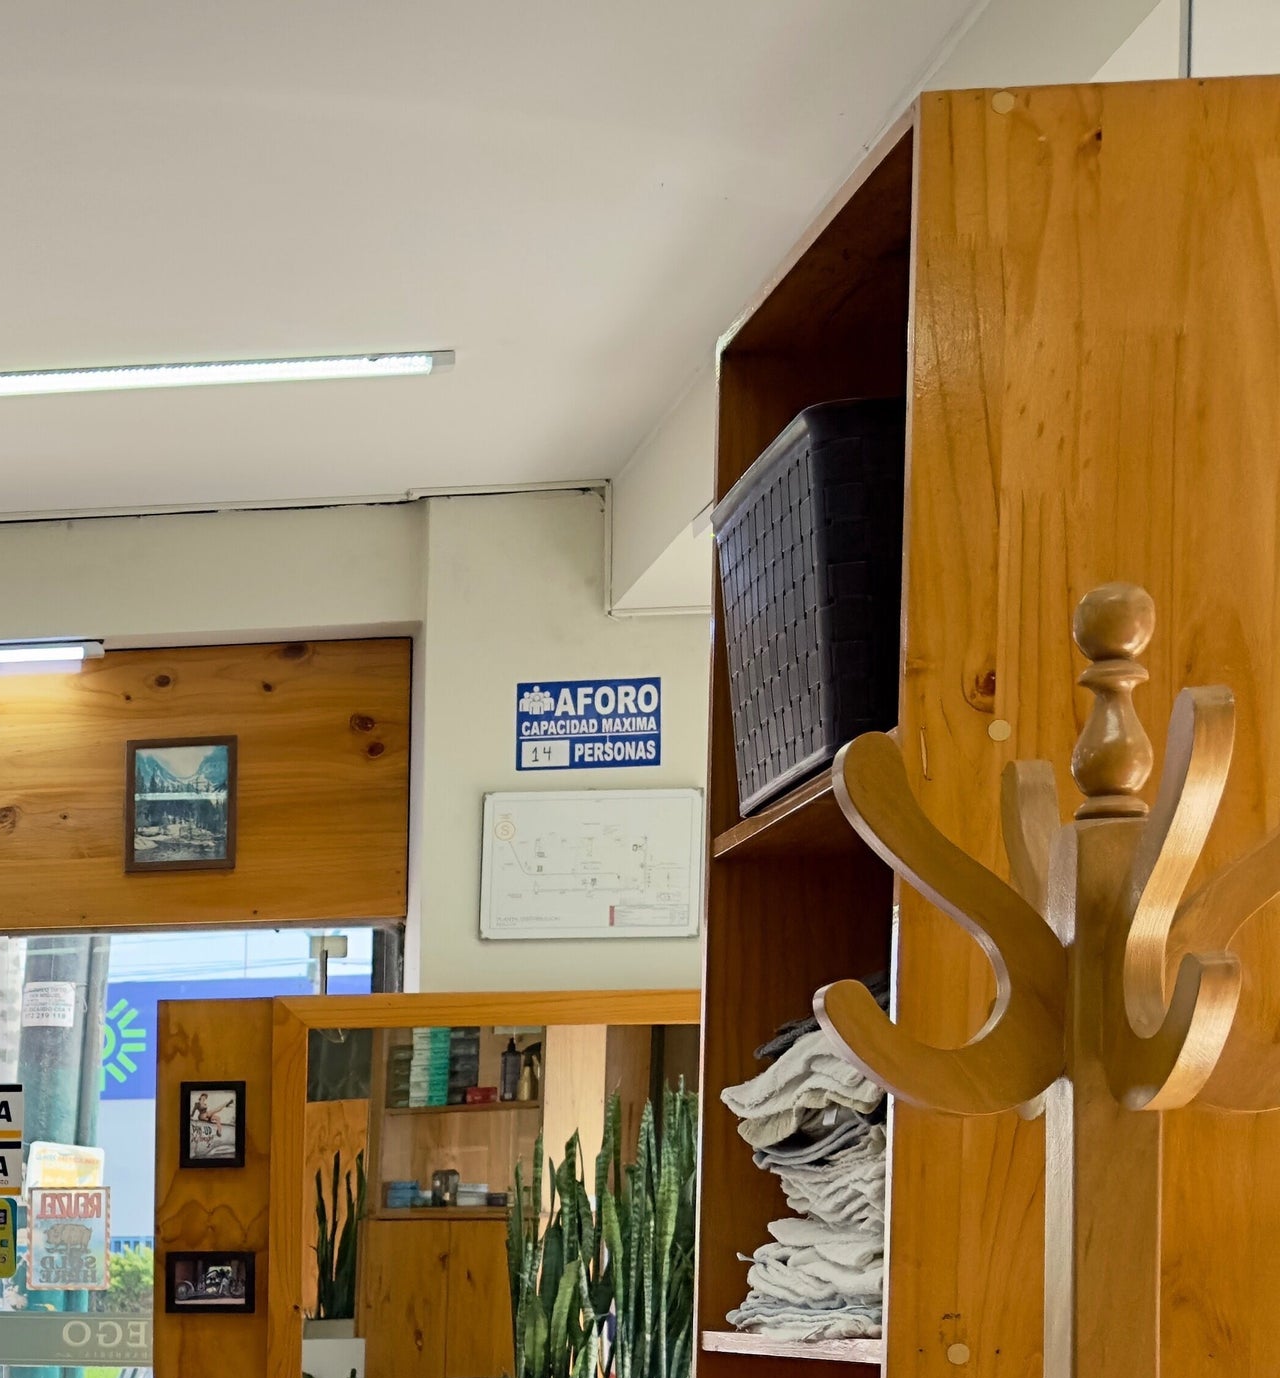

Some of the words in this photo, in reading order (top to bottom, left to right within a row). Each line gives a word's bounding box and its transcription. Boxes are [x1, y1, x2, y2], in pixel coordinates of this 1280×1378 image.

[554, 684, 659, 717] AFORO
[521, 719, 598, 736] CAPACIDAD
[601, 716, 657, 733] MAXIMA
[531, 746, 552, 762] 14
[574, 740, 656, 762] PERSONAS
